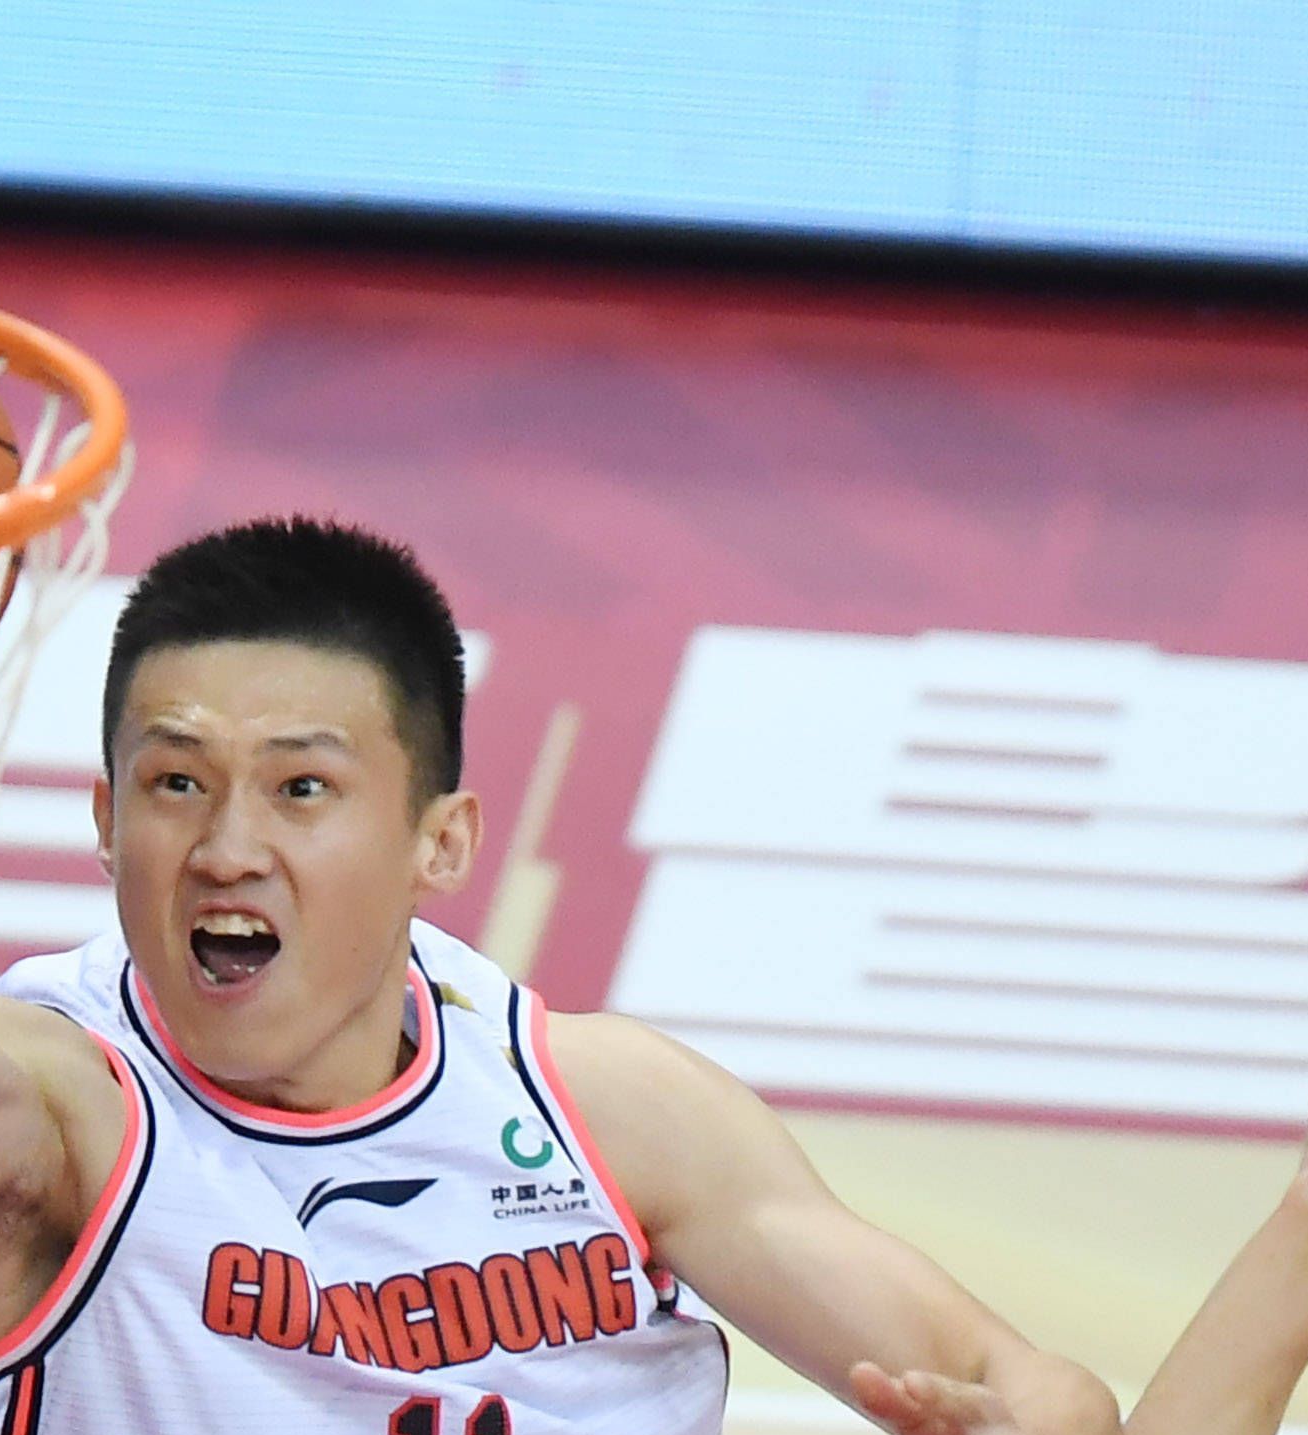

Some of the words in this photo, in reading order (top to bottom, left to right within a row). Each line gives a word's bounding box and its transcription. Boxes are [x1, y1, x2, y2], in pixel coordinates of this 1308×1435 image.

[493, 1205, 548, 1219] CHINA
[554, 1198, 590, 1212] LIFE
[202, 1232, 637, 1374] GUANGDONG
